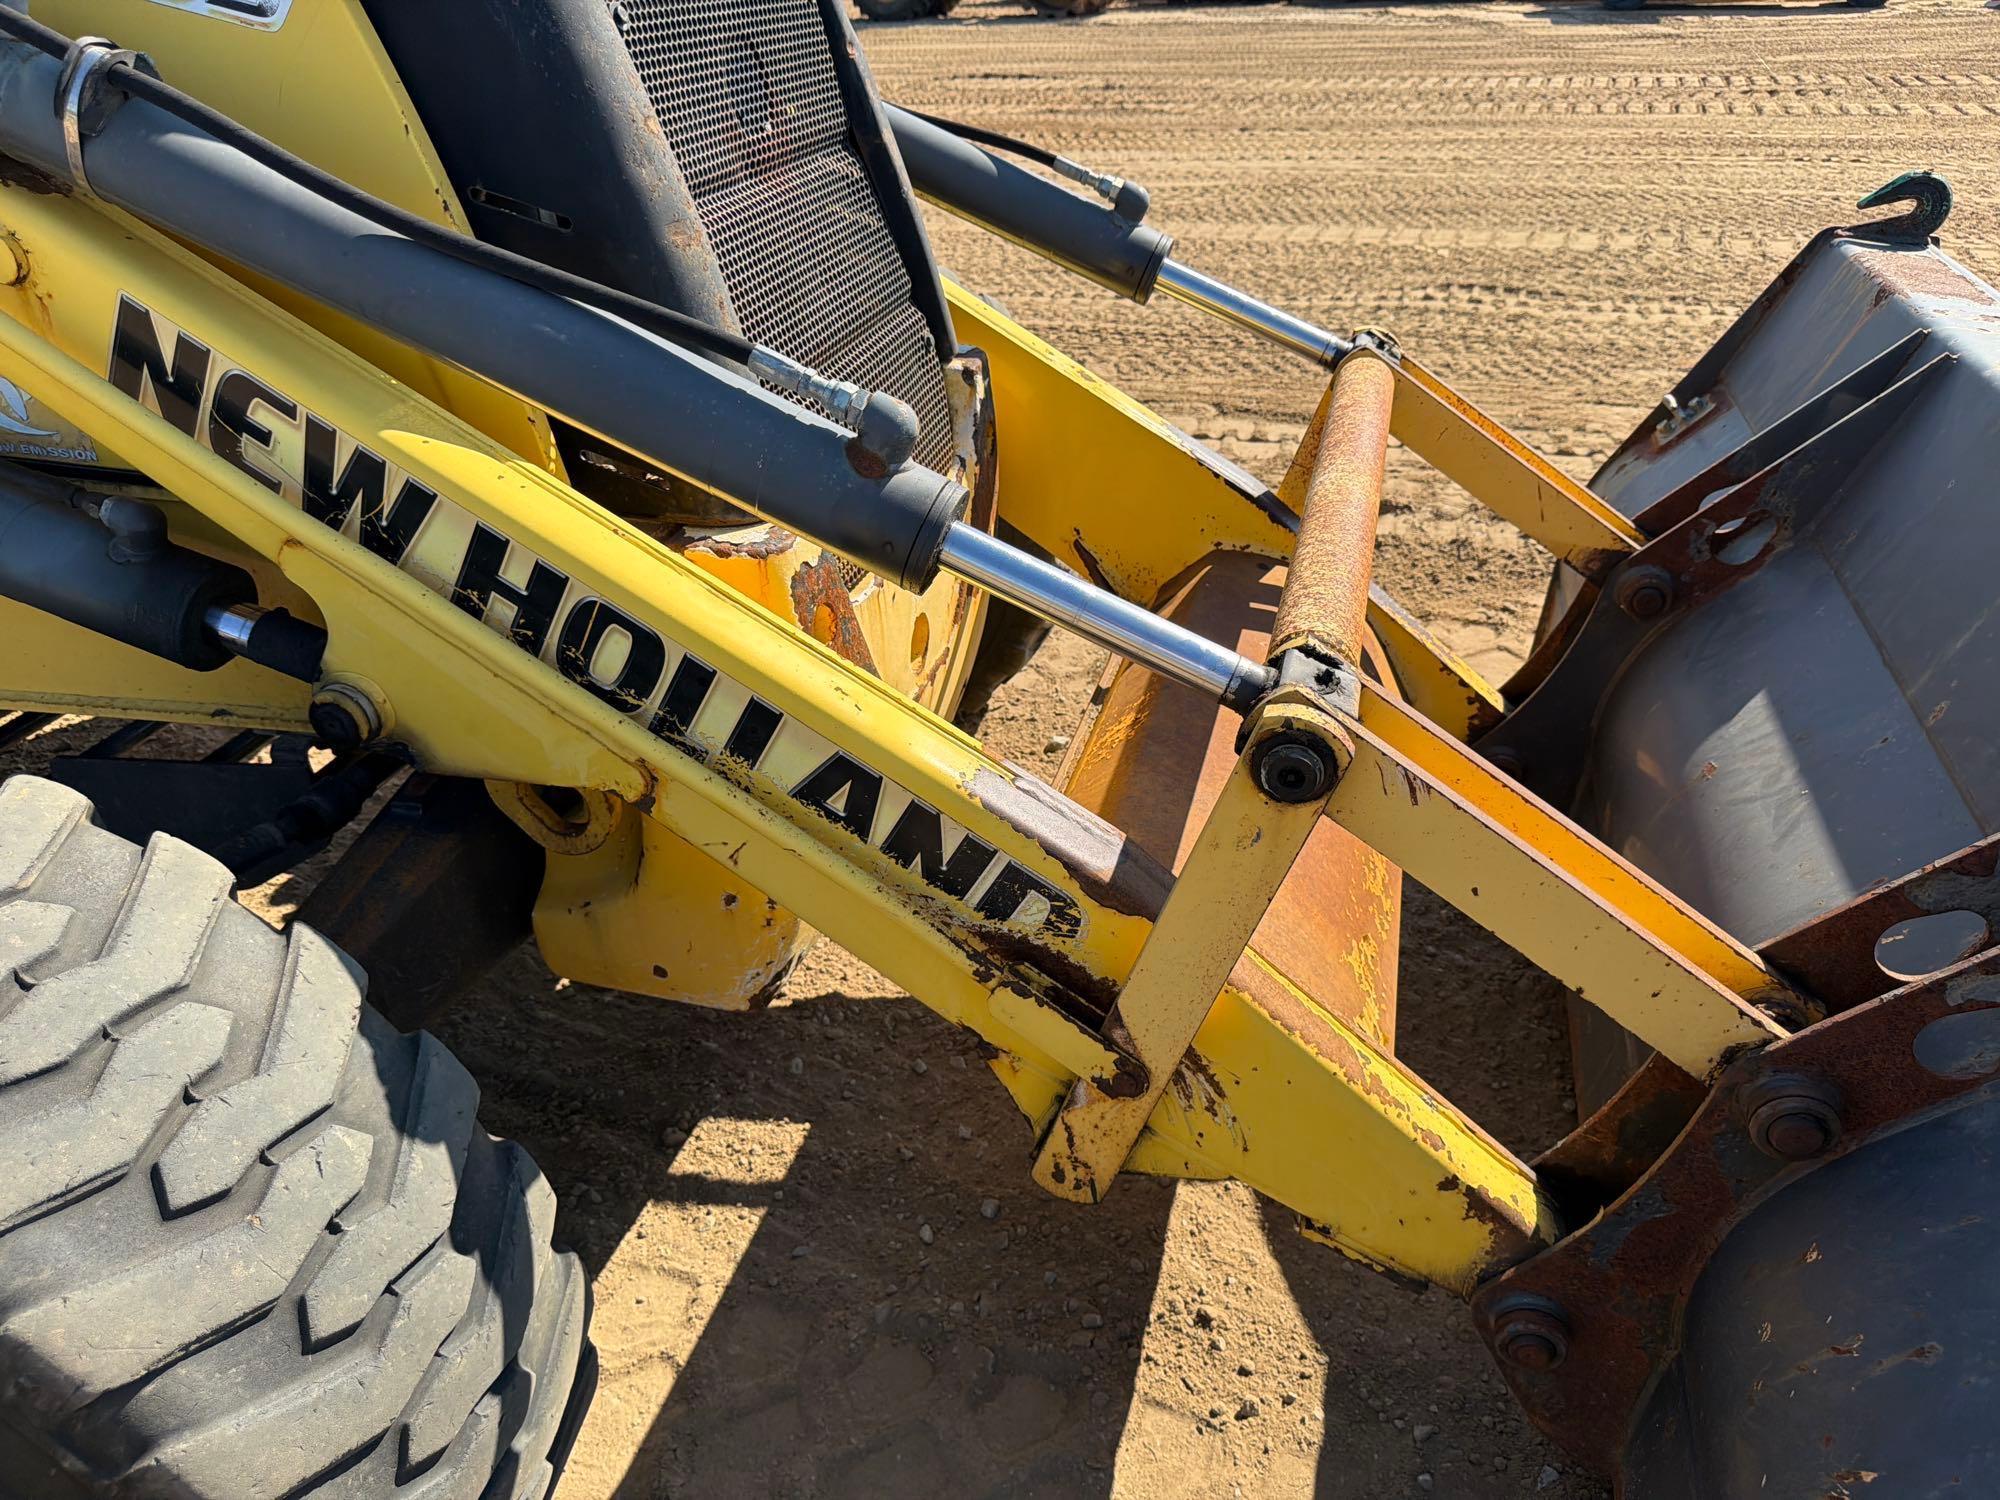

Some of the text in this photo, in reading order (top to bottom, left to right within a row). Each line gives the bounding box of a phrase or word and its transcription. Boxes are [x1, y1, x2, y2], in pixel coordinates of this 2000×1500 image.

[20, 443, 97, 461] EMISSION
[107, 292, 1084, 940] NEW HOLLAND
